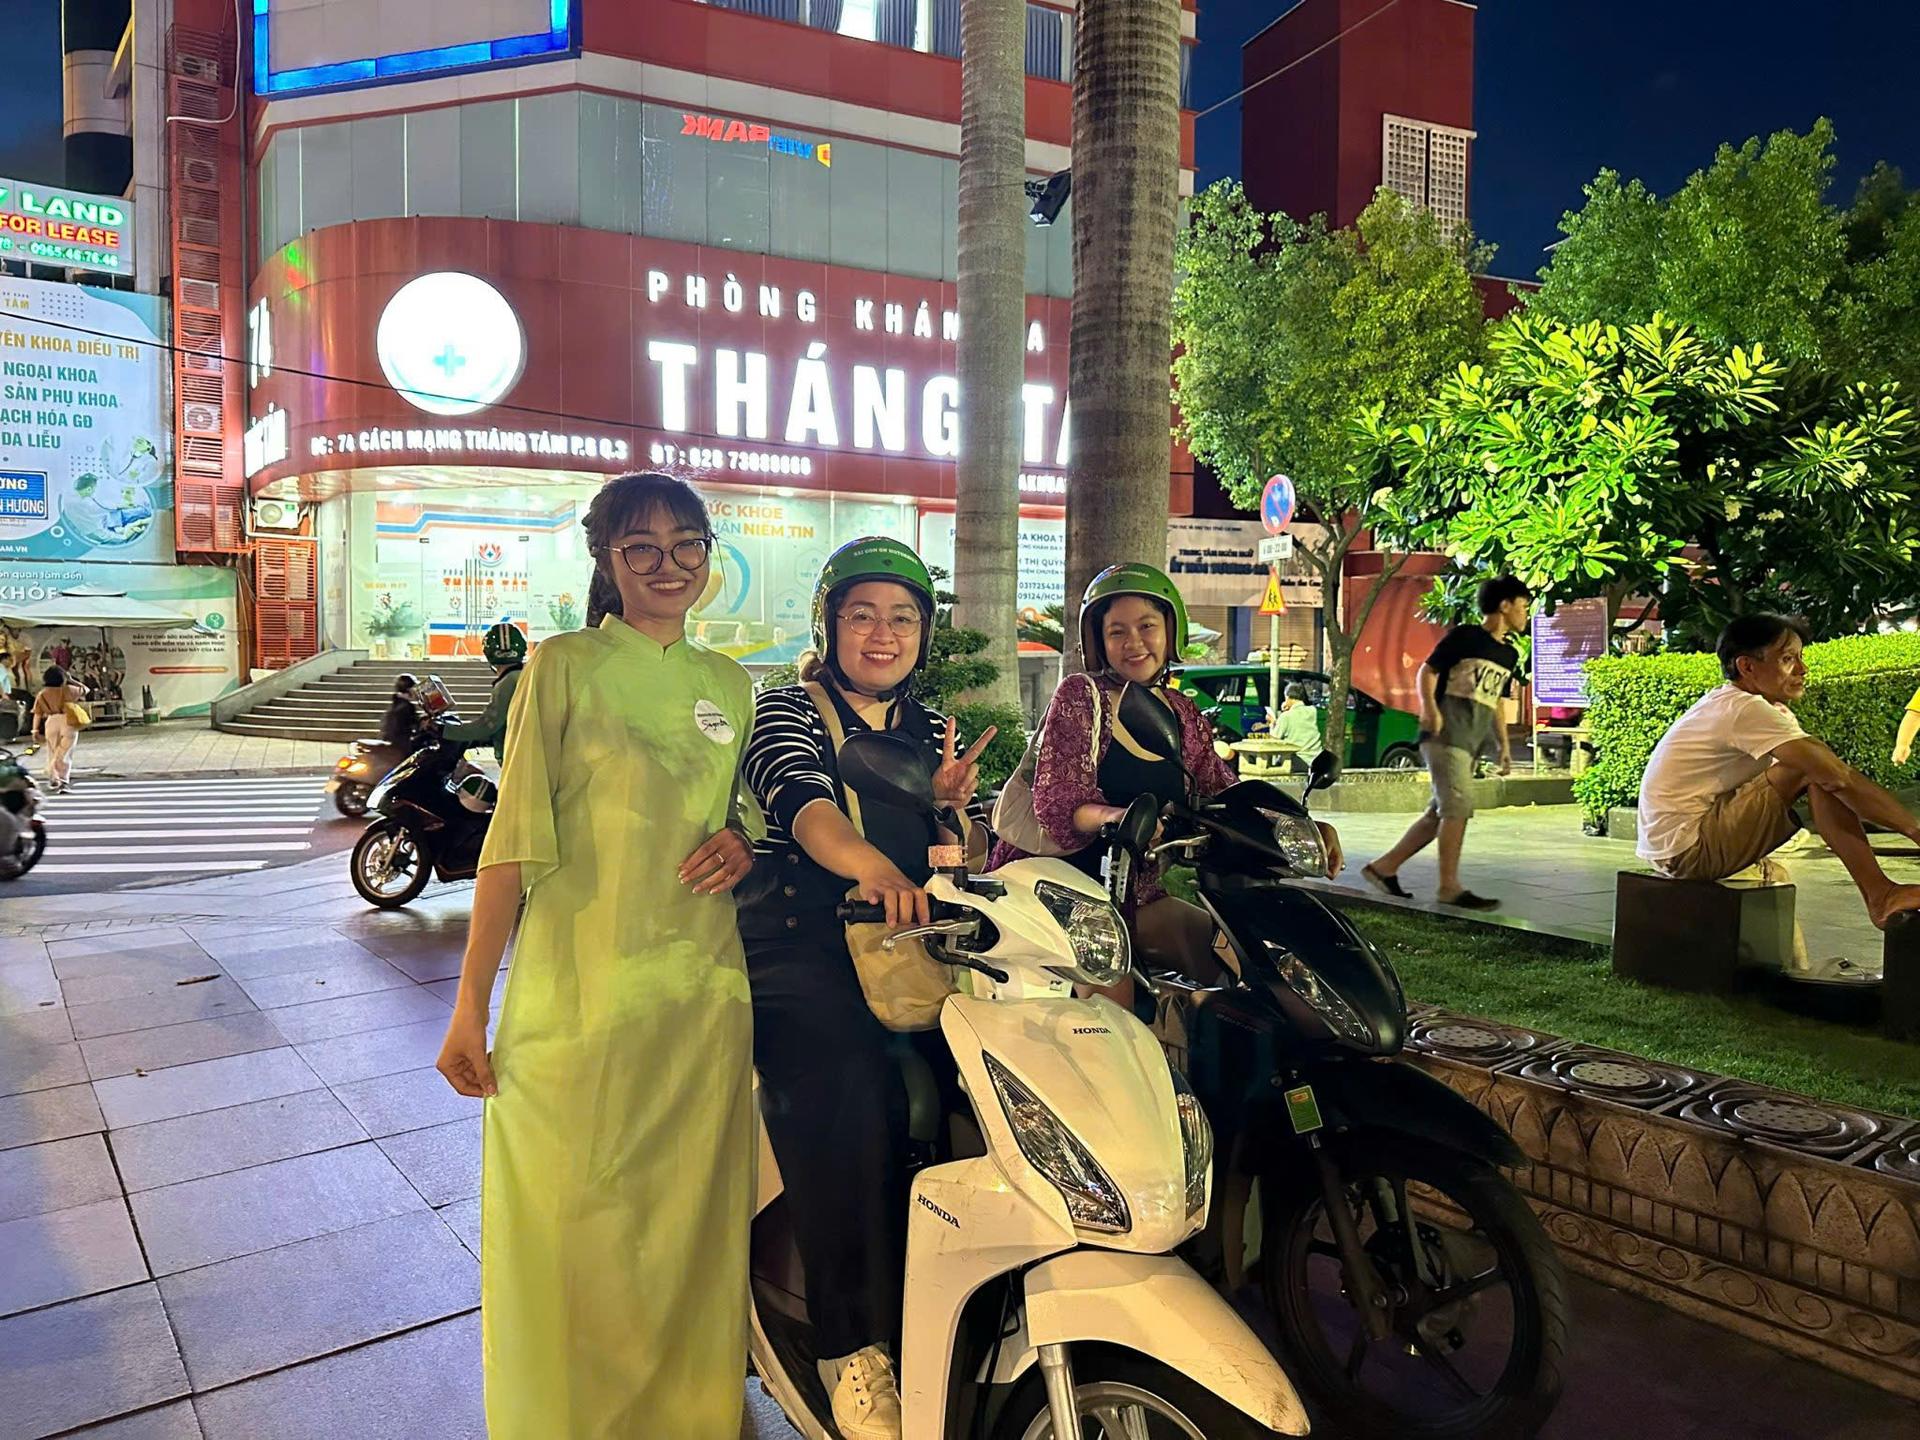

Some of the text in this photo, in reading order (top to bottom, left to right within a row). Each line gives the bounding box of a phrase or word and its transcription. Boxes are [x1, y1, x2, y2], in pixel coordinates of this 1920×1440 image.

[22, 191, 124, 227] LAND
[46, 221, 120, 249] LEASE
[648, 270, 817, 323] PHÒNG
[31, 335, 73, 353] KHOA
[117, 344, 140, 363] TRỊ
[3, 361, 98, 384] NGOẠI KHOA
[4, 381, 119, 408] SẢN PHỤ KHOA
[648, 341, 959, 456] THÁNG
[0, 408, 32, 426] ẠCH
[73, 414, 93, 429] GĐ
[1, 429, 61, 449] DA LIỄU
[359, 427, 404, 452] CÁCH
[406, 429, 463, 453] MẠNG
[465, 428, 528, 453] THÁNG
[529, 430, 568, 455] TÁM
[787, 525, 814, 539] TIN
[1031, 533, 1056, 542] KHOA
[0, 545, 28, 553] AM.VN
[1072, 1027, 1111, 1035] HONDA
[917, 1192, 961, 1229] HONDA
